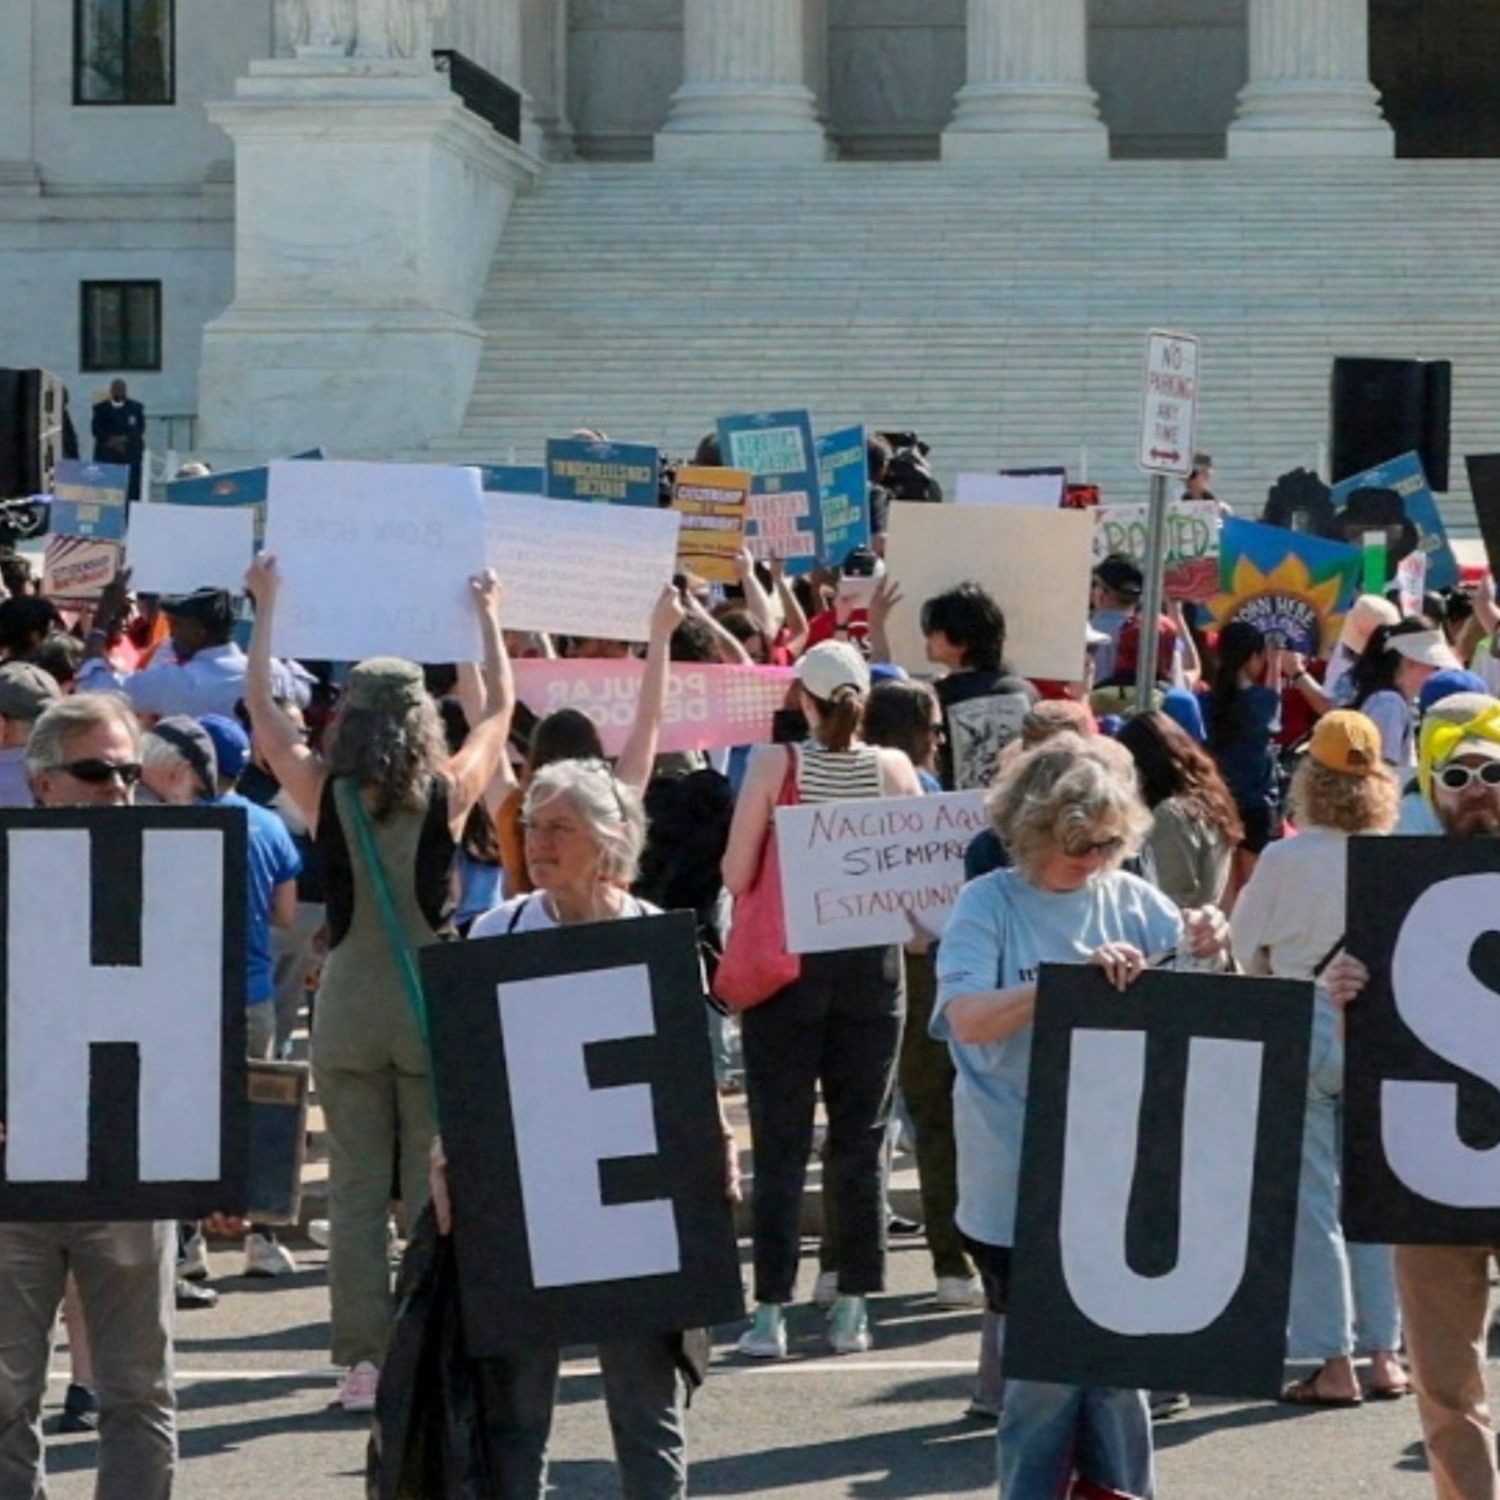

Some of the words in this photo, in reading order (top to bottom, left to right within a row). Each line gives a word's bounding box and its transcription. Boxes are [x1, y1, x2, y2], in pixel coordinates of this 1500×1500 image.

[1162, 343, 1182, 370] NO
[1149, 371, 1194, 400] PARKING
[1158, 401, 1180, 419] ANY
[1154, 421, 1179, 444] TIME
[808, 808, 924, 849] NACIDO
[841, 838, 968, 876] SIEMPRE
[6, 828, 225, 1182] H
[497, 963, 681, 1290] E
[1059, 1027, 1265, 1336] U
